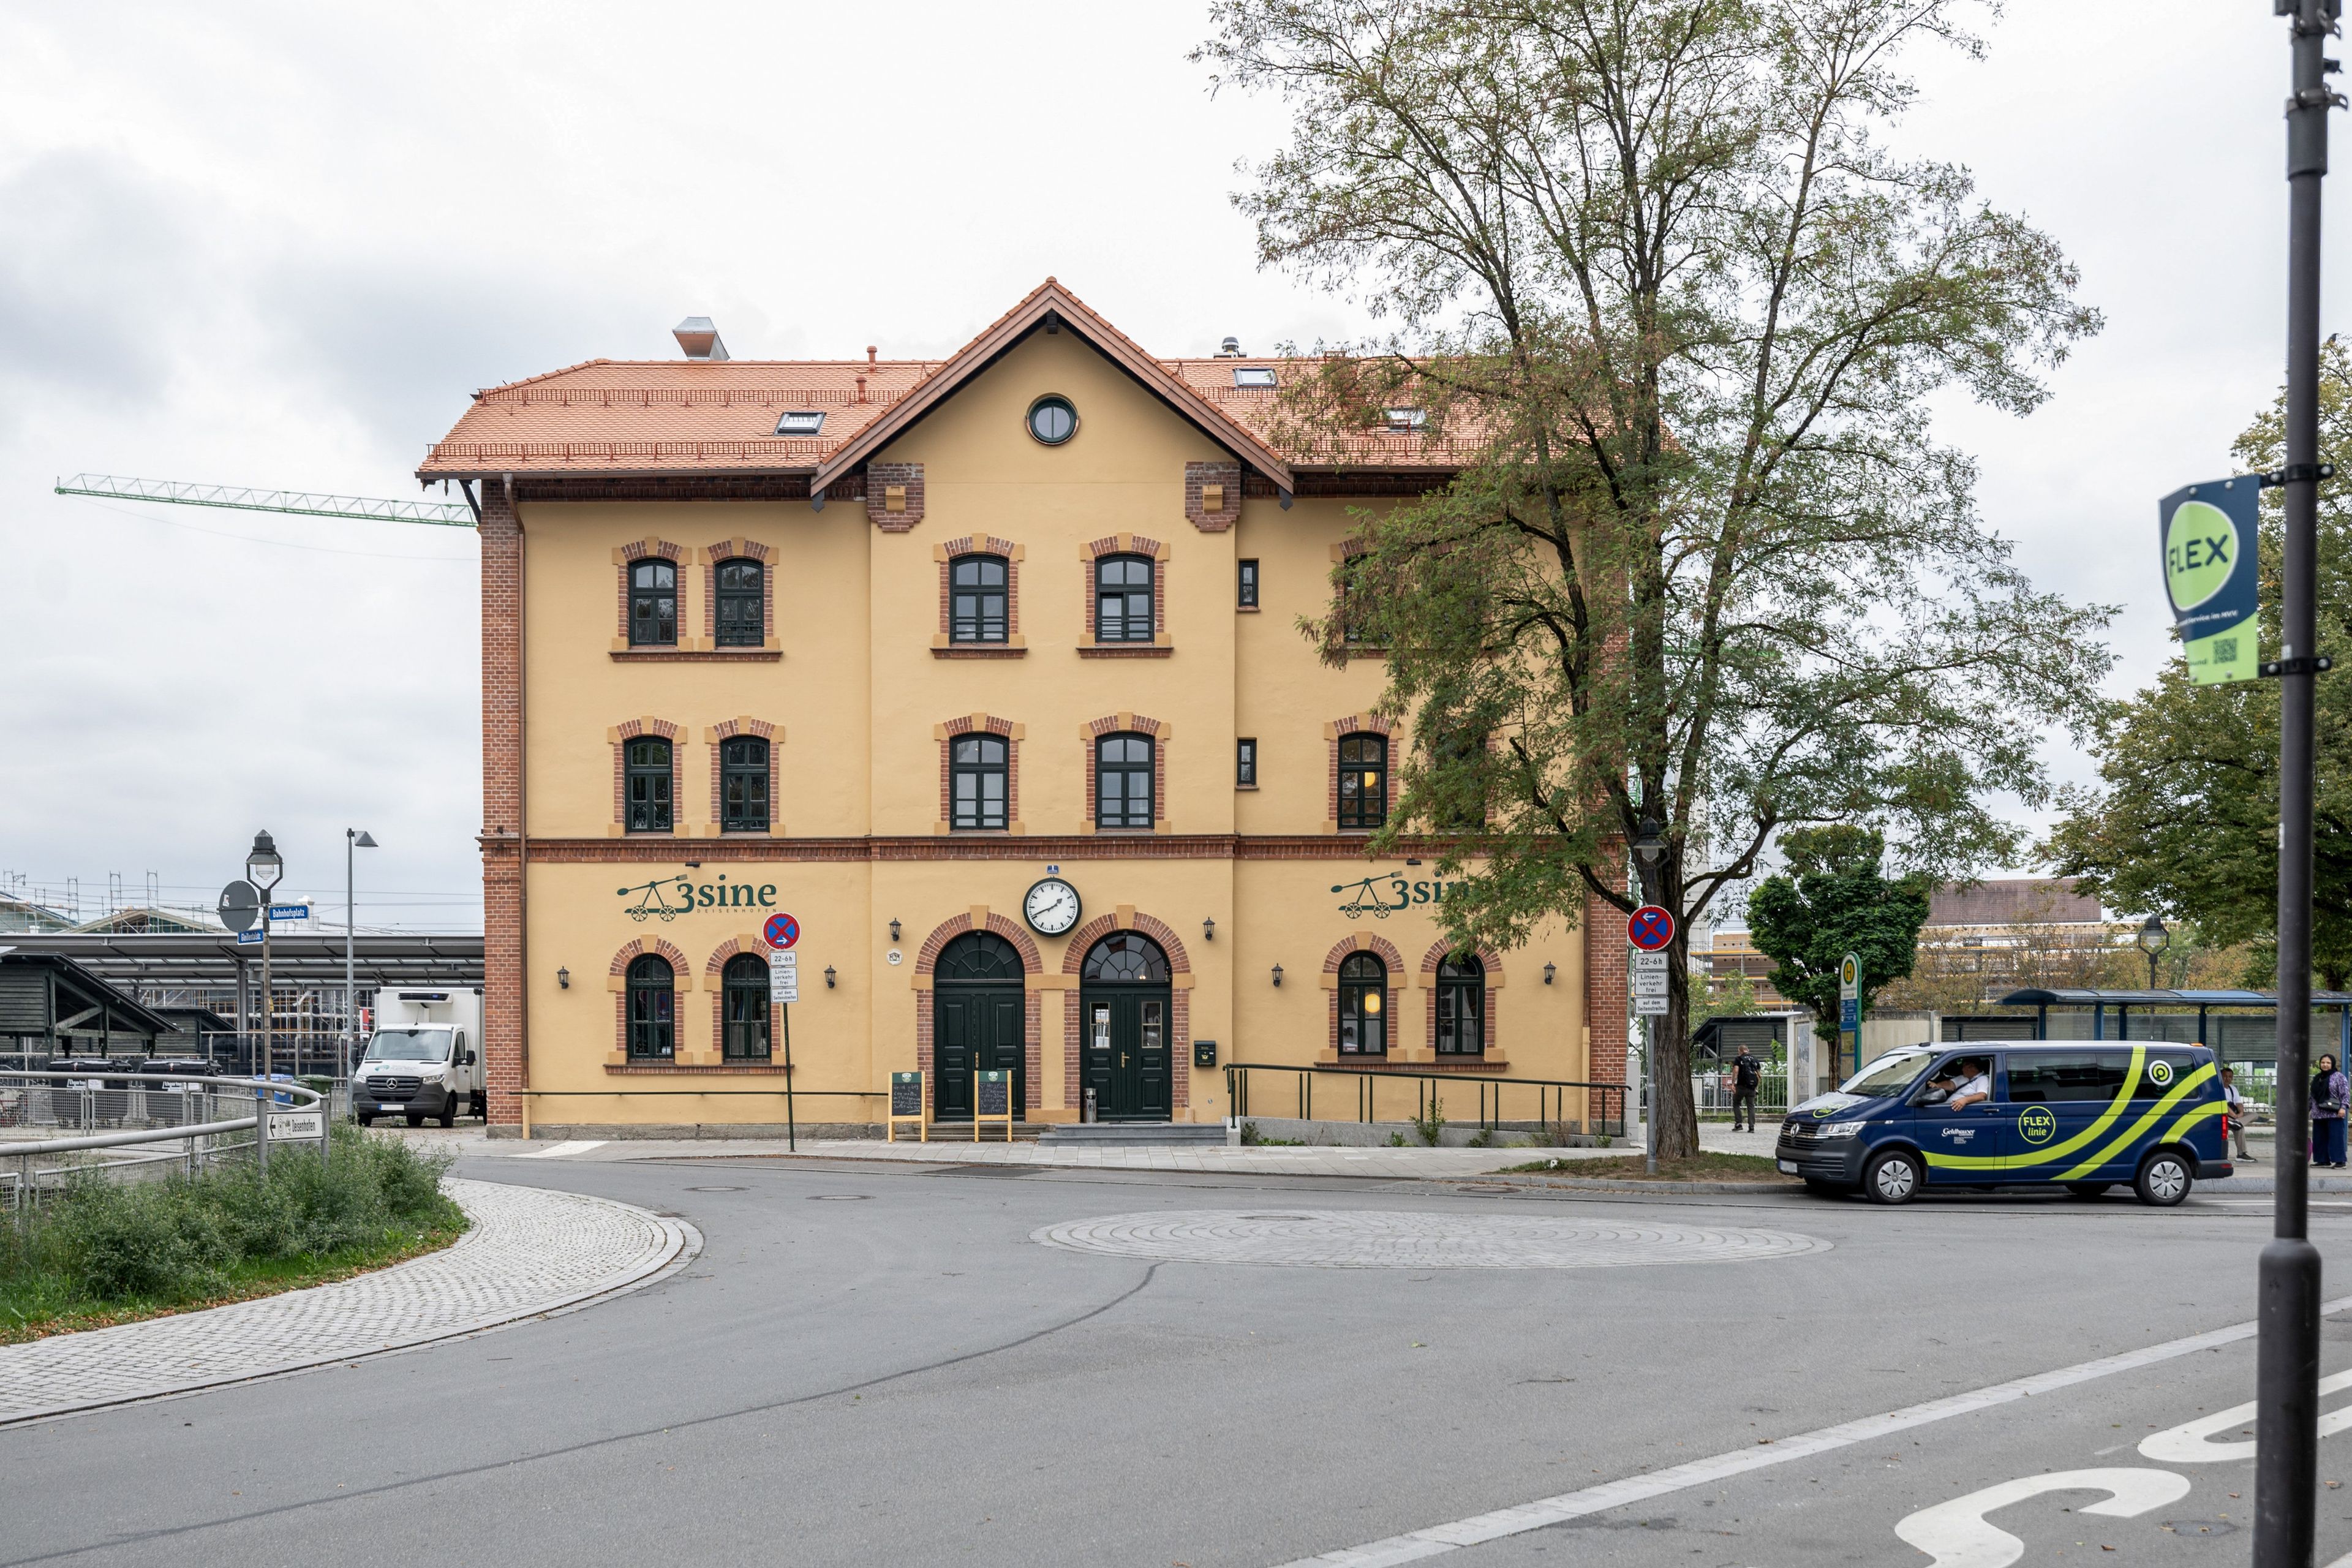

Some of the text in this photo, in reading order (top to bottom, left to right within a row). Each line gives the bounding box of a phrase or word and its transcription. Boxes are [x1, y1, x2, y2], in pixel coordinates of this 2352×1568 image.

[2169, 534, 2228, 578] FLEX
[677, 874, 777, 913] 3sine
[273, 908, 305, 918] Bahnhofsplatz
[292, 1118, 315, 1133] Deisenhofen
[2023, 1116, 2050, 1126] FLEX
[1942, 1128, 1975, 1137] Geldhauser
[2028, 1127, 2046, 1136] linie
